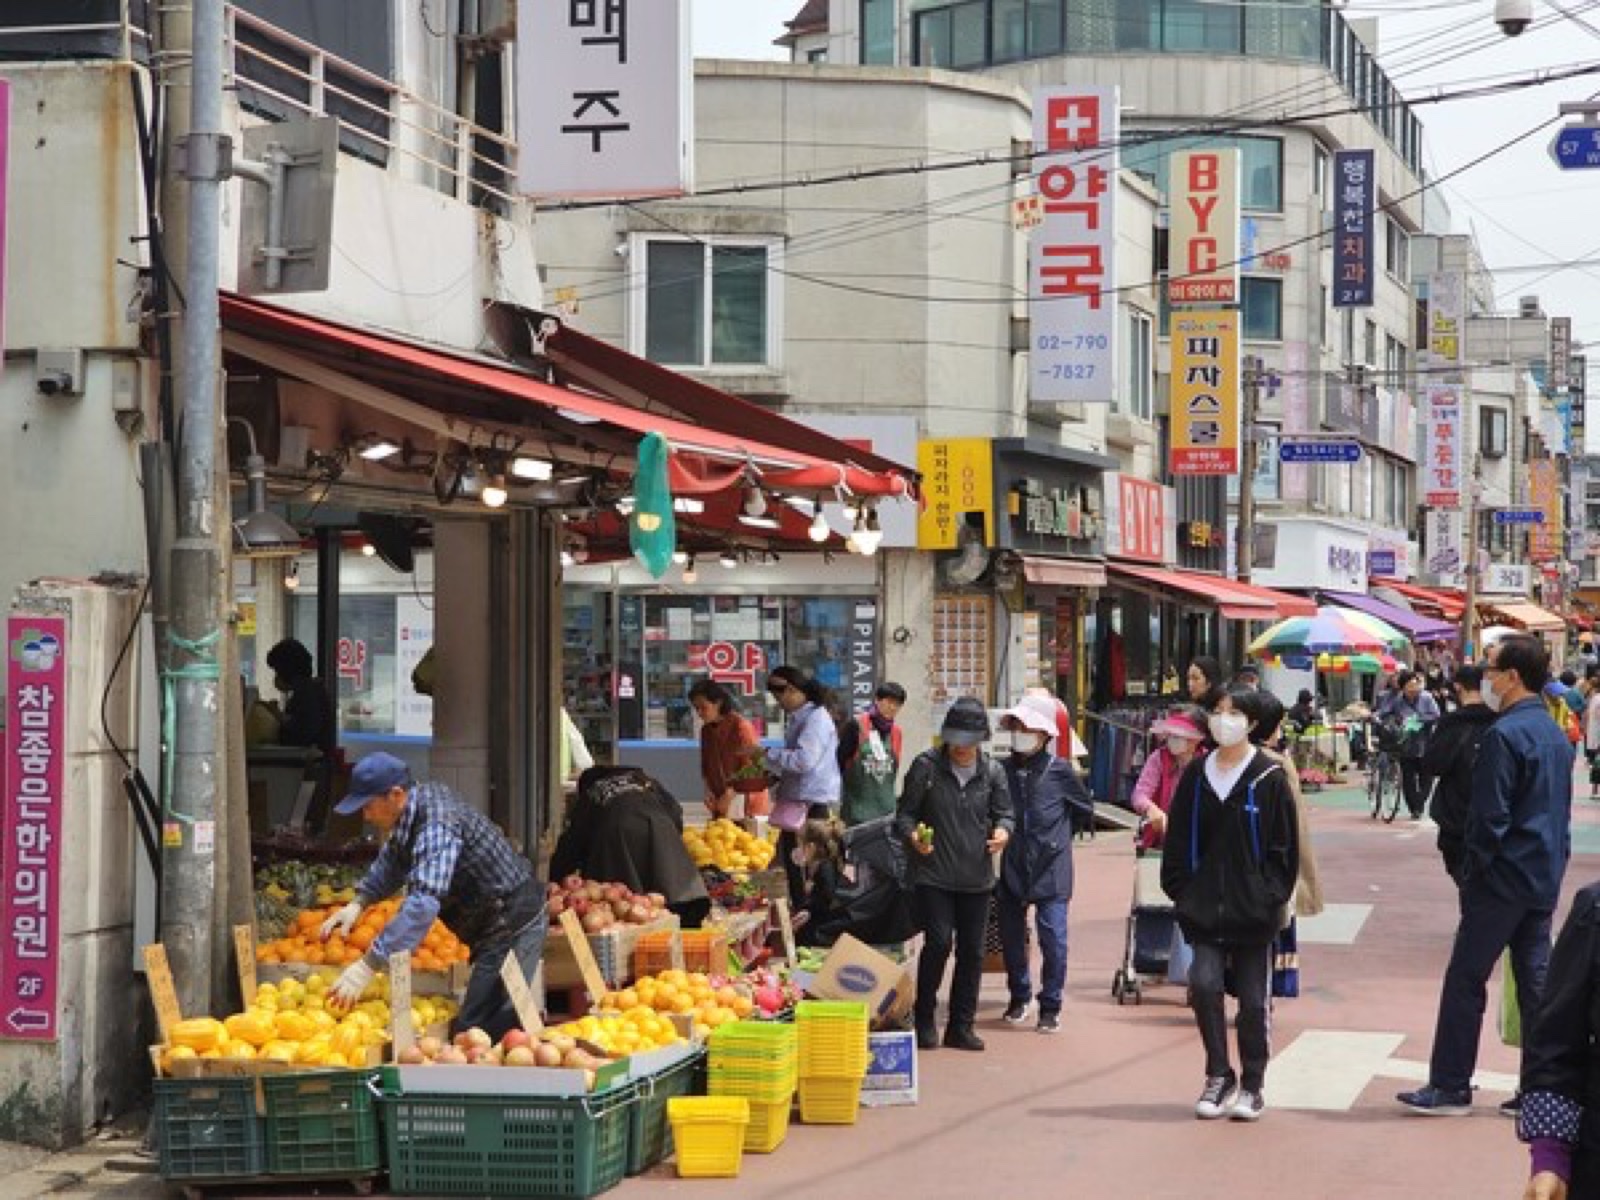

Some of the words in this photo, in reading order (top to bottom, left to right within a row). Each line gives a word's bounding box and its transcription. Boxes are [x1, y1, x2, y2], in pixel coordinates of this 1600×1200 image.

[560, 0, 630, 153] 맥주
[1562, 141, 1579, 155] 57
[1038, 164, 1109, 310] 약국
[1188, 154, 1220, 274] BYC
[1341, 290, 1365, 302] 2F
[1038, 334, 1108, 351] 02-790
[1185, 337, 1223, 444] 피자스쿨
[705, 641, 766, 697] 약
[12, 684, 54, 960] 참좋은한의원
[18, 976, 43, 997] 2F
